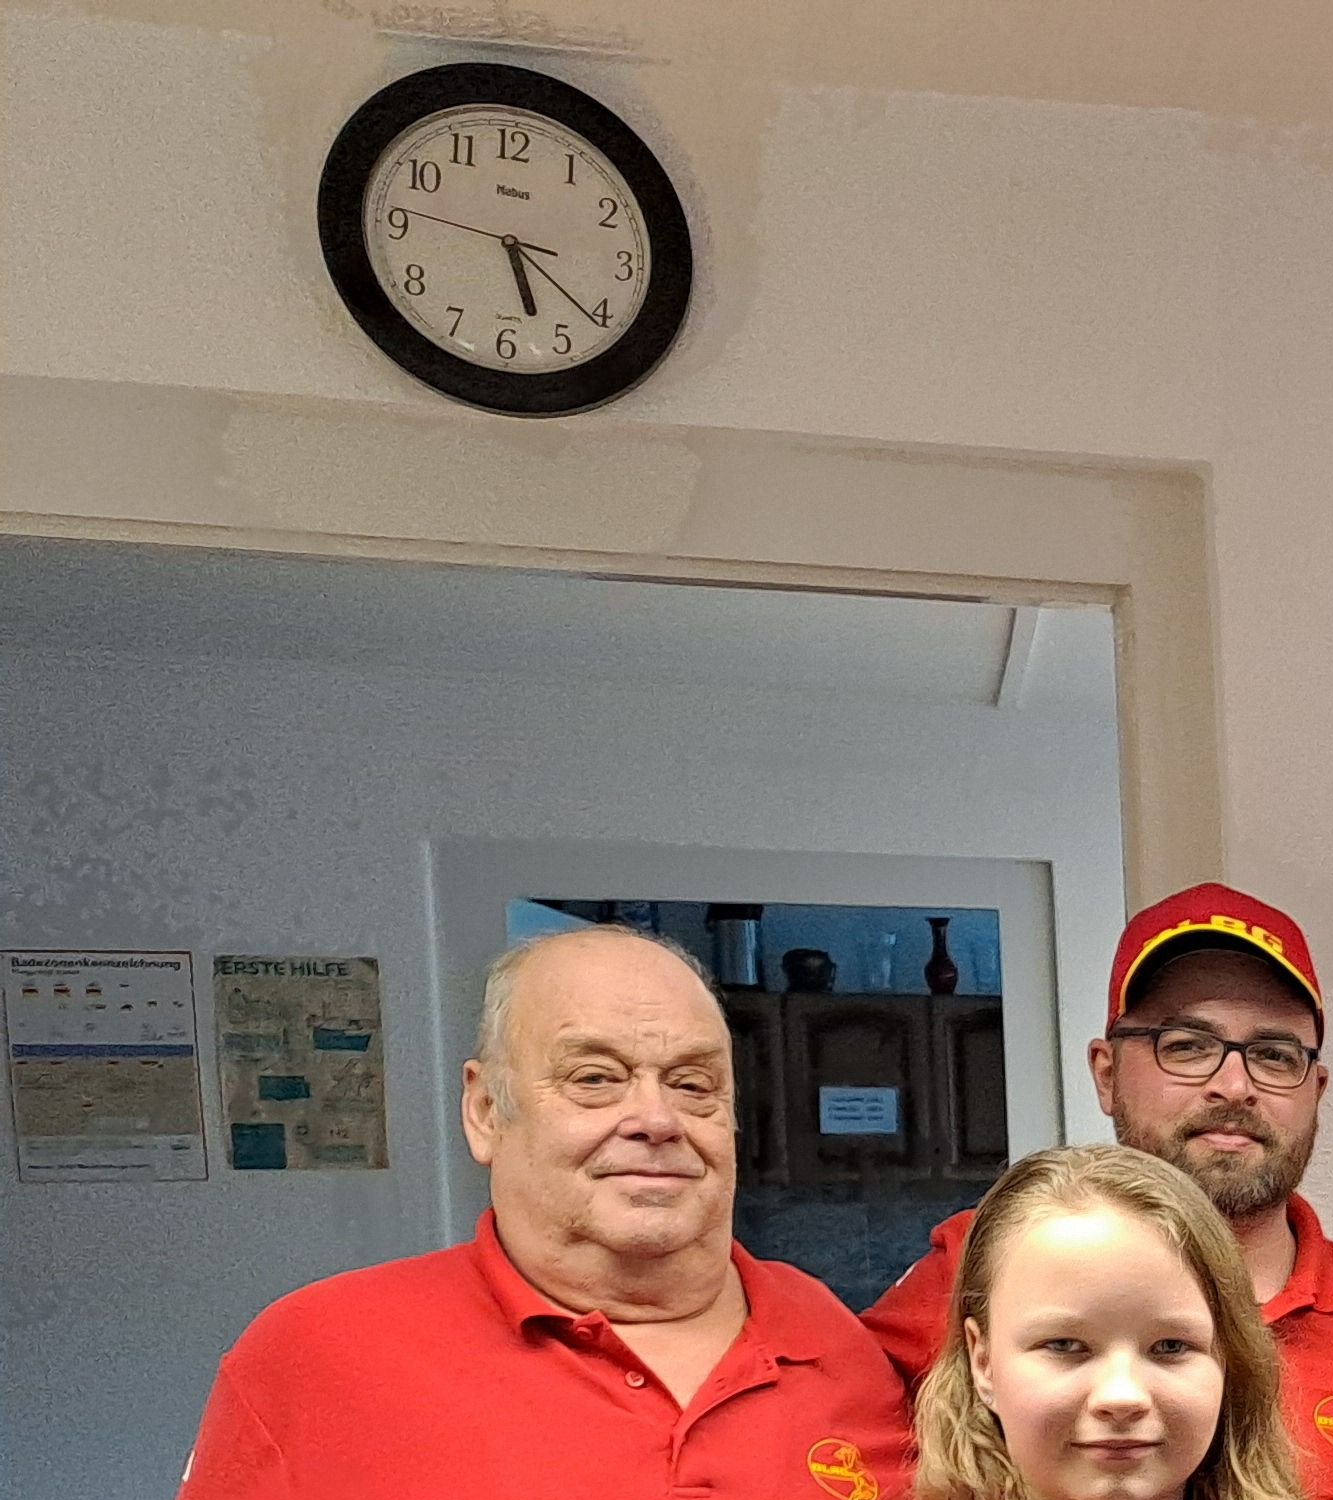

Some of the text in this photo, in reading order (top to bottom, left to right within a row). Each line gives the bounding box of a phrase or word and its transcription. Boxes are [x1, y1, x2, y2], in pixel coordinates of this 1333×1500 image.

[449, 132, 477, 167] 11
[496, 128, 531, 164] 12
[408, 158, 442, 193] 10
[564, 153, 577, 185] 1
[387, 207, 409, 240] 9
[598, 197, 619, 229] 2
[403, 263, 427, 297] 8
[614, 250, 634, 282] 3
[445, 305, 465, 338] 7
[591, 296, 614, 329] 4
[495, 328, 518, 360] 6
[552, 323, 573, 355] 5
[221, 960, 350, 977] ERSTE HILFE
